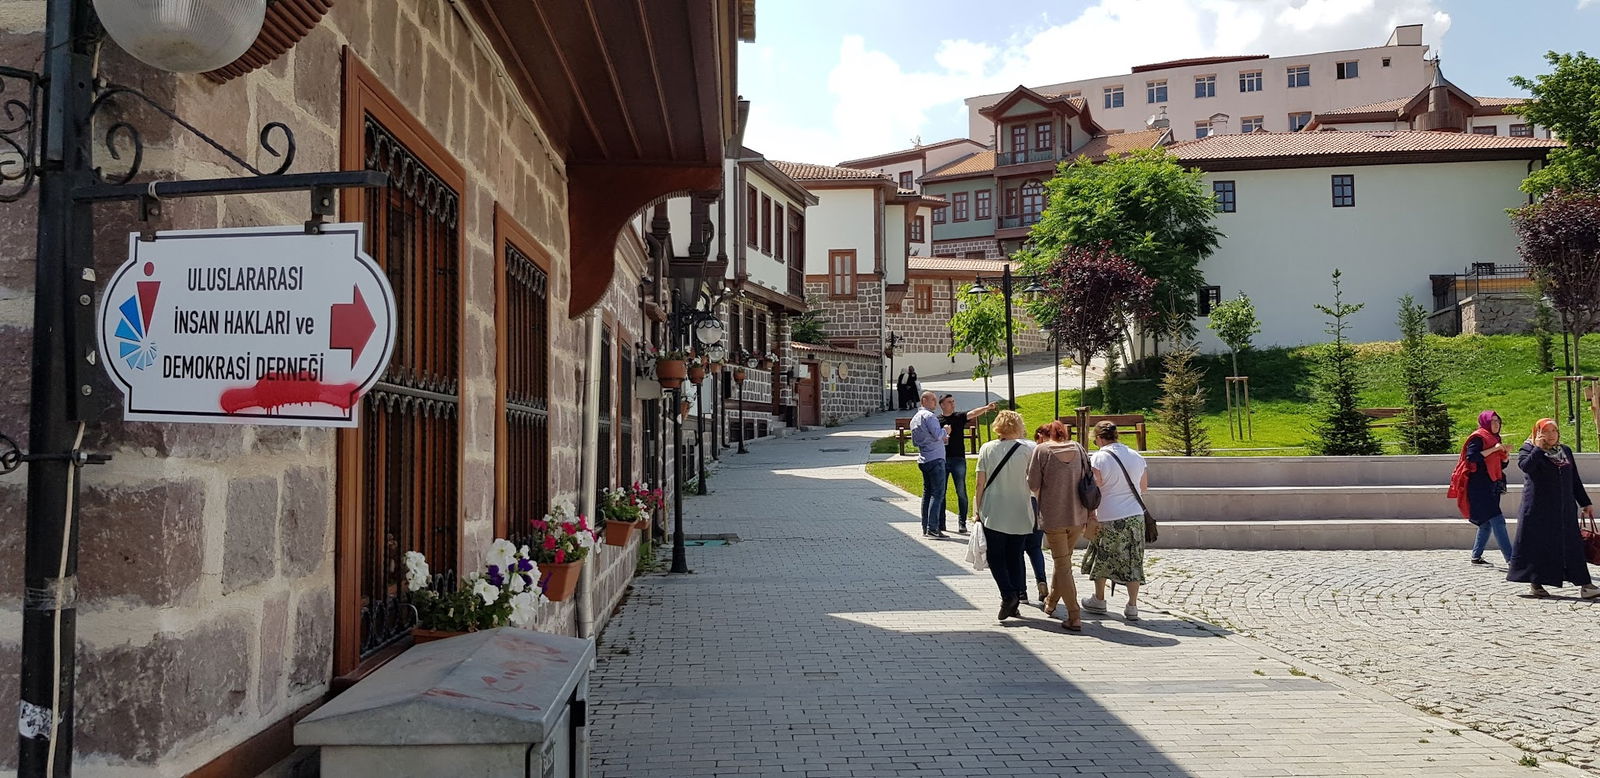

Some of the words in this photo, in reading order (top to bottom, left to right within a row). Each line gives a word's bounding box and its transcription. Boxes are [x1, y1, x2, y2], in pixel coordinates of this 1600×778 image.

[188, 266, 303, 291] ULUSLARARASI
[174, 306, 219, 334] İNSAN
[224, 310, 291, 335] HAKLARI
[296, 317, 315, 335] ve
[163, 352, 251, 380] DEMOKRASİ
[256, 353, 324, 382] DERNEĞİ
